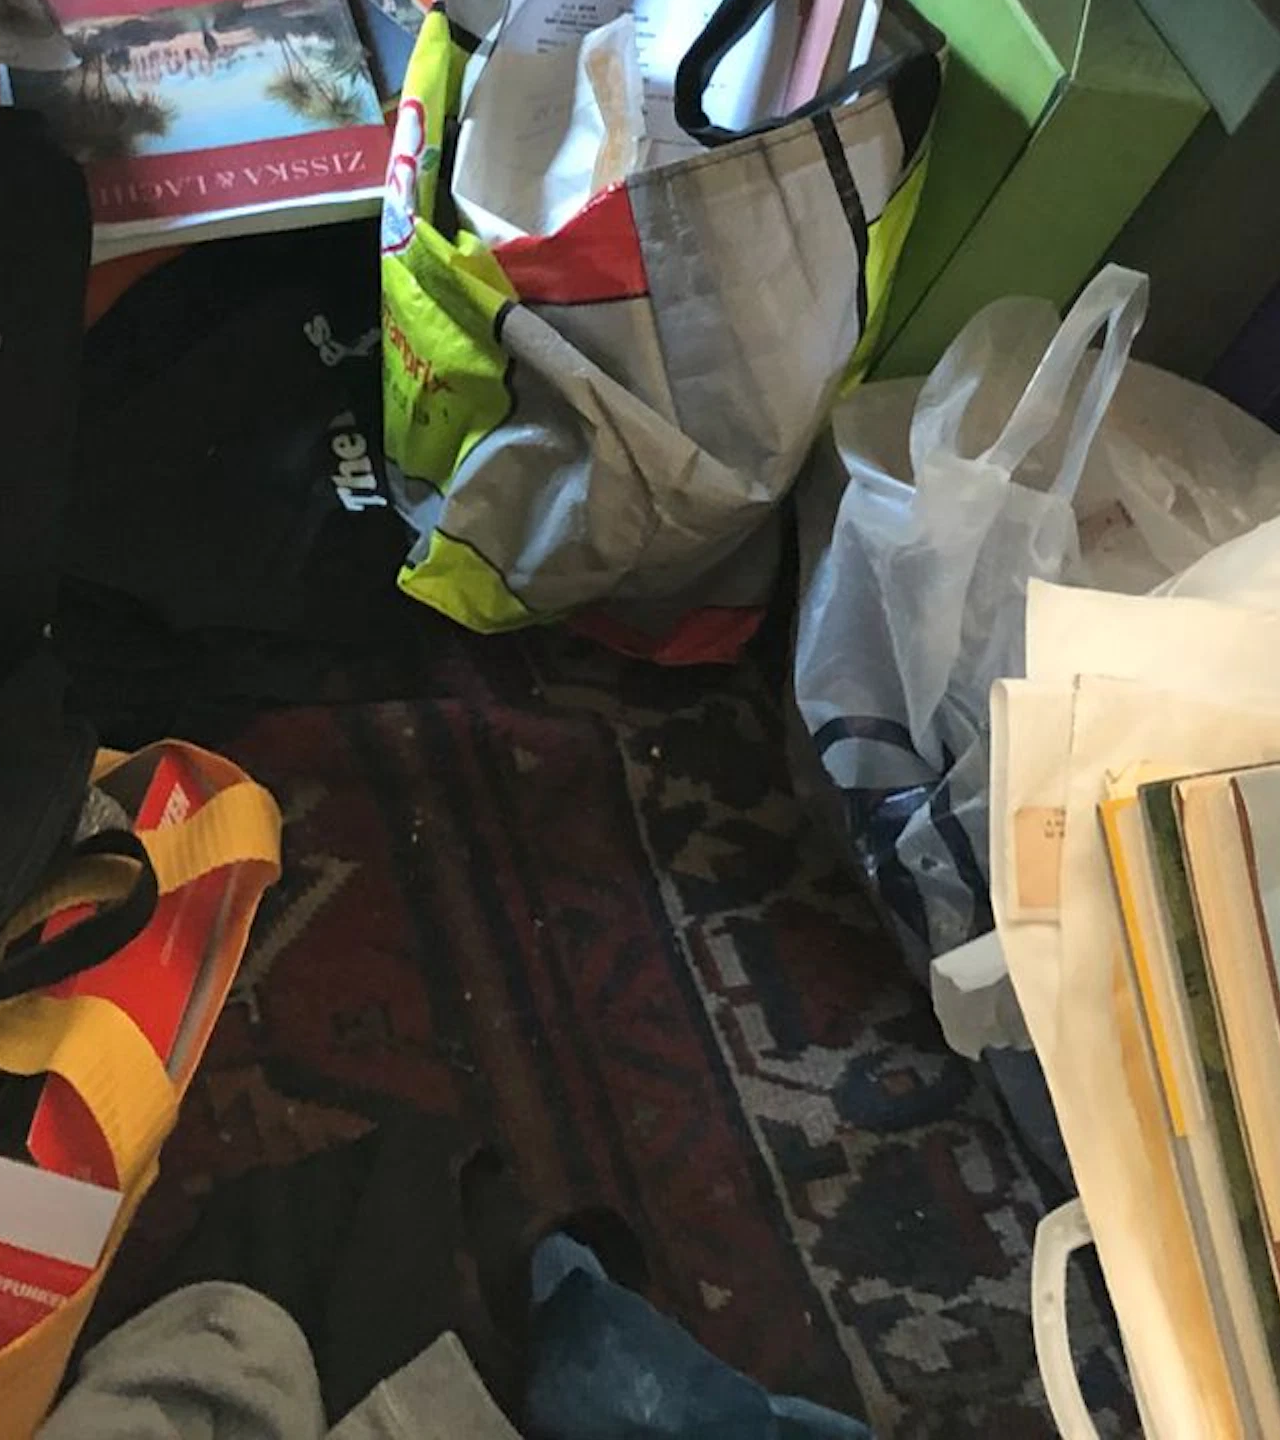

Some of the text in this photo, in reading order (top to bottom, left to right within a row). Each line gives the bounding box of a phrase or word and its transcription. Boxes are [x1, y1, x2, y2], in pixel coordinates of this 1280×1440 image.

[99, 150, 365, 205] ZISSKA & LACH
[332, 432, 387, 512] The
